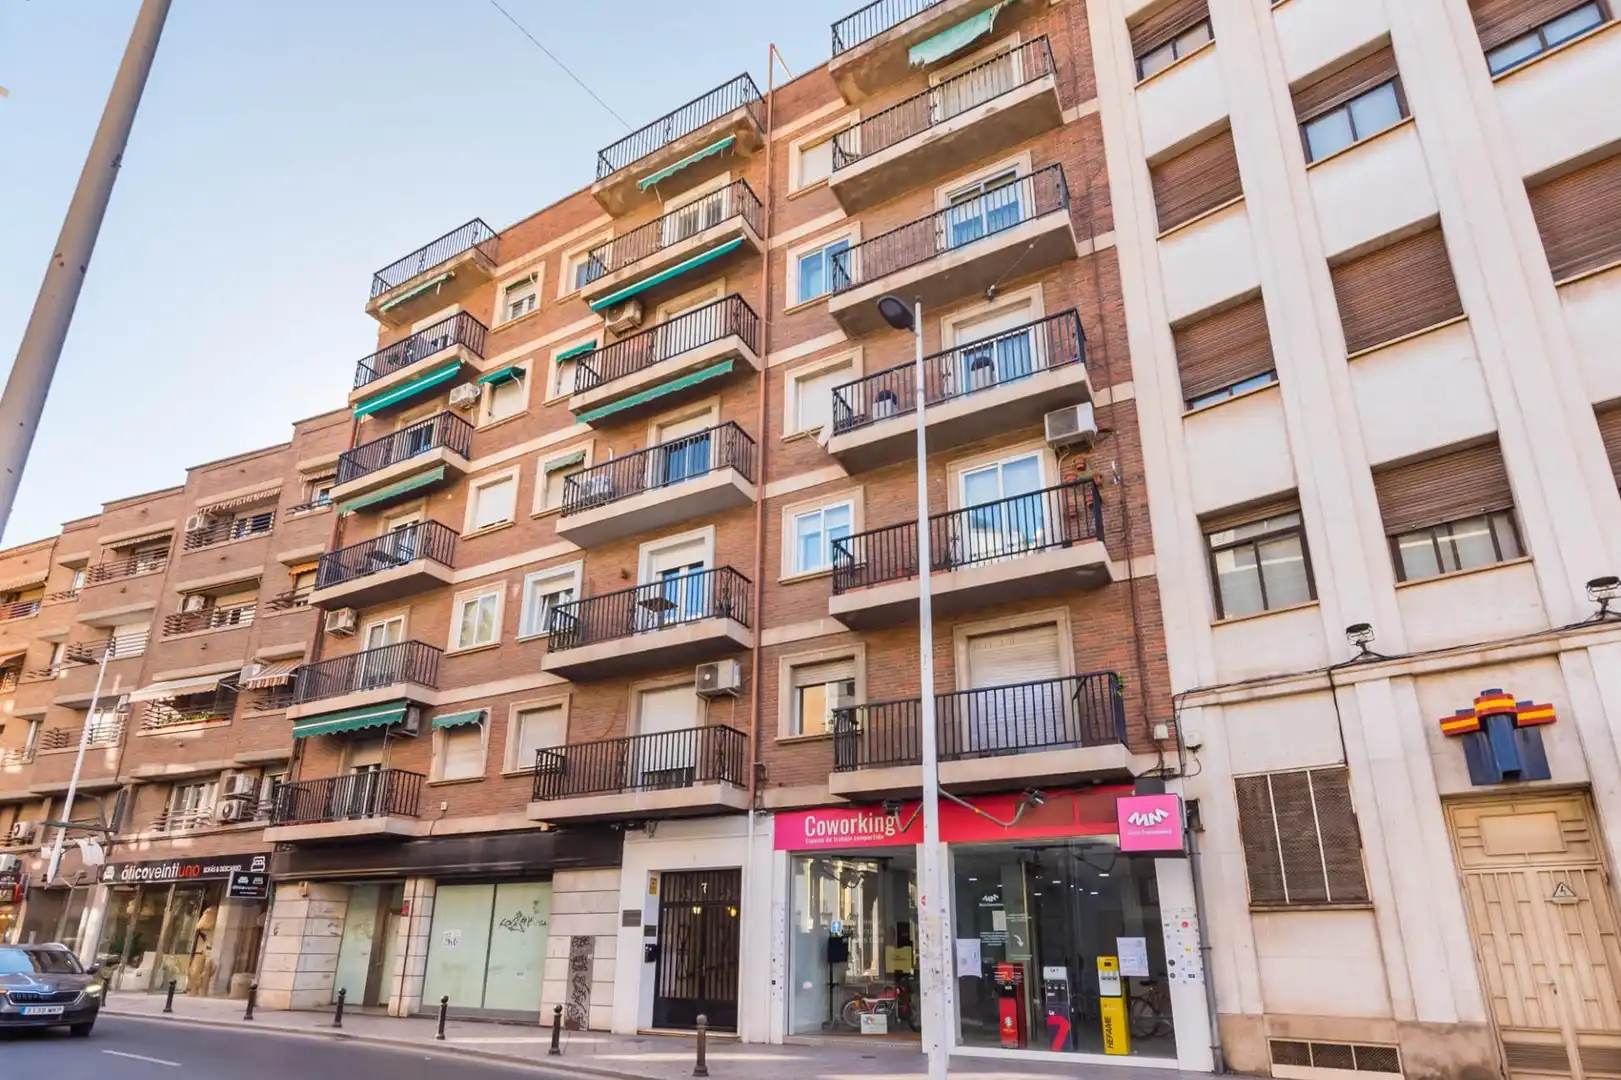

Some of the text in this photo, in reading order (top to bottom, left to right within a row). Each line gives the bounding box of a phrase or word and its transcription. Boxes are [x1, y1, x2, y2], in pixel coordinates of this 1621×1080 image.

[805, 812, 895, 836] Coworking
[701, 882, 708, 894] 7
[1047, 1015, 1070, 1052] 7
[1104, 1016, 1114, 1049] HEFAME
